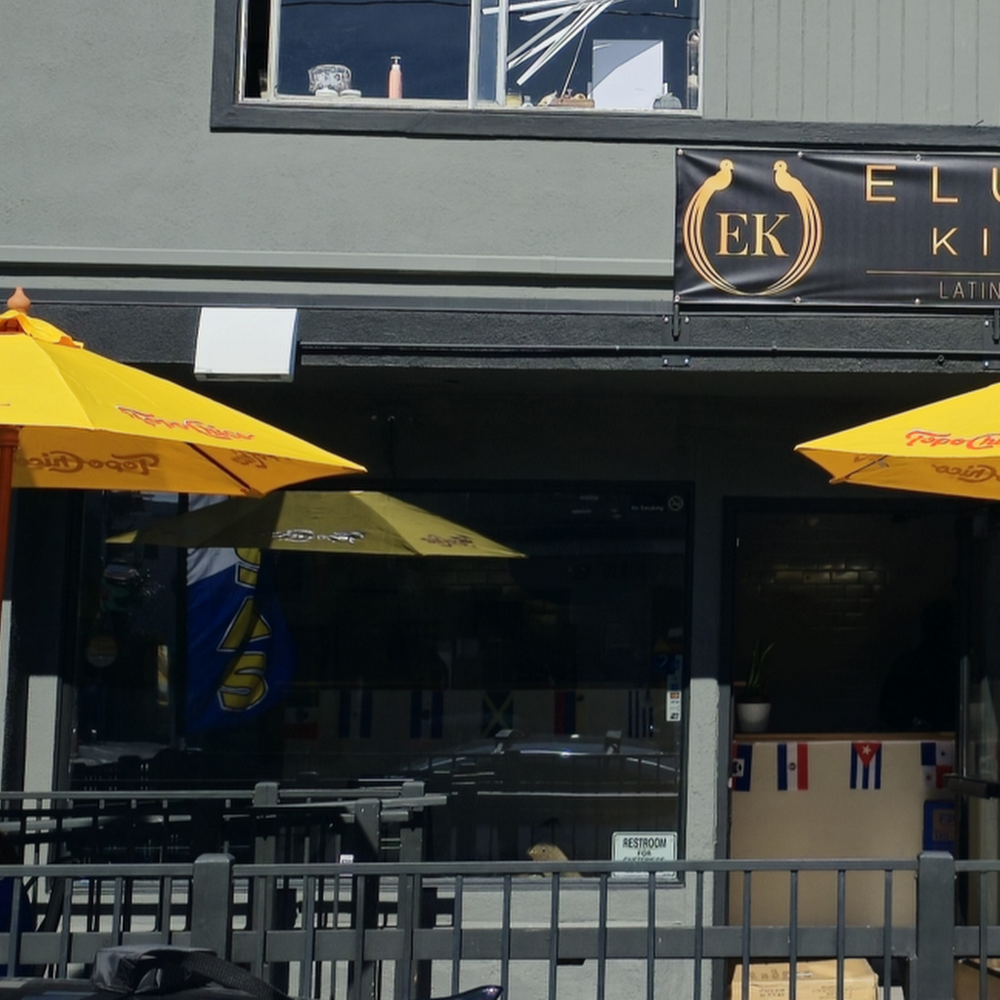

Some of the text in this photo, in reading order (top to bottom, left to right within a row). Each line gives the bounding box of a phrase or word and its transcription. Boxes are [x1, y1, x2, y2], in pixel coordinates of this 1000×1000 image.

[715, 212, 790, 257] EK
[905, 429, 967, 447] Topo
[622, 837, 667, 848] RESTROOM
